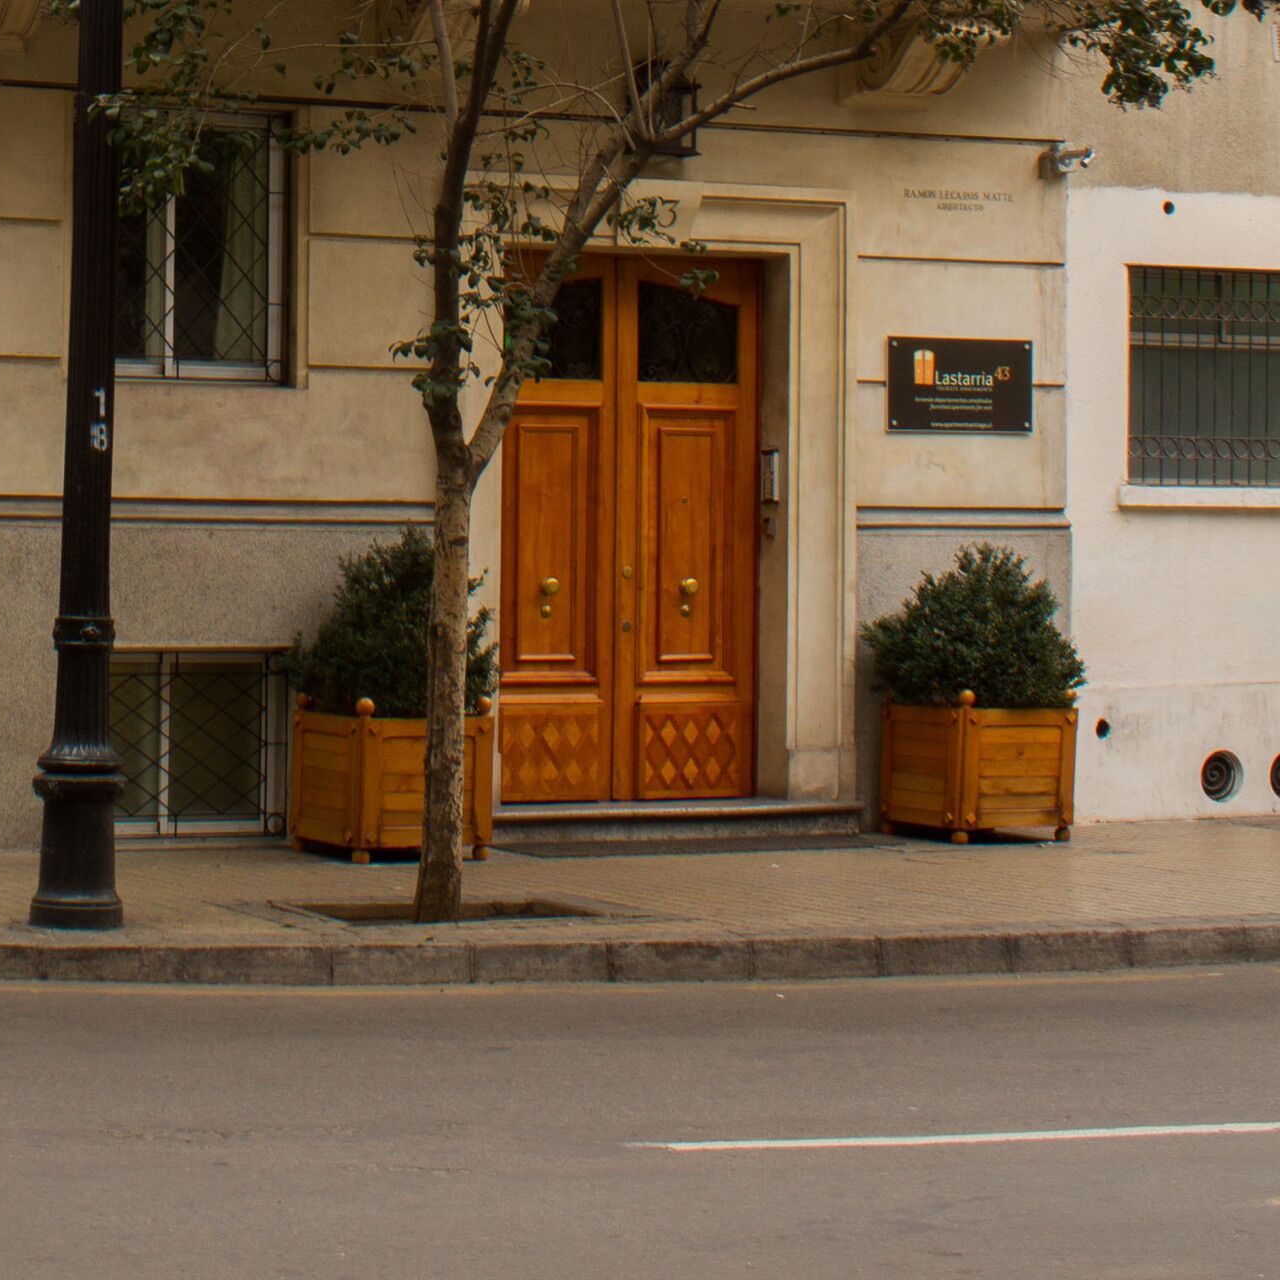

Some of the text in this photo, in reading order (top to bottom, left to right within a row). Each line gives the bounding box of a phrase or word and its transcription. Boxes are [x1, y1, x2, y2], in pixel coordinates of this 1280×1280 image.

[983, 192, 1014, 202] MATTE
[935, 366, 1011, 386] Lastarria 43
